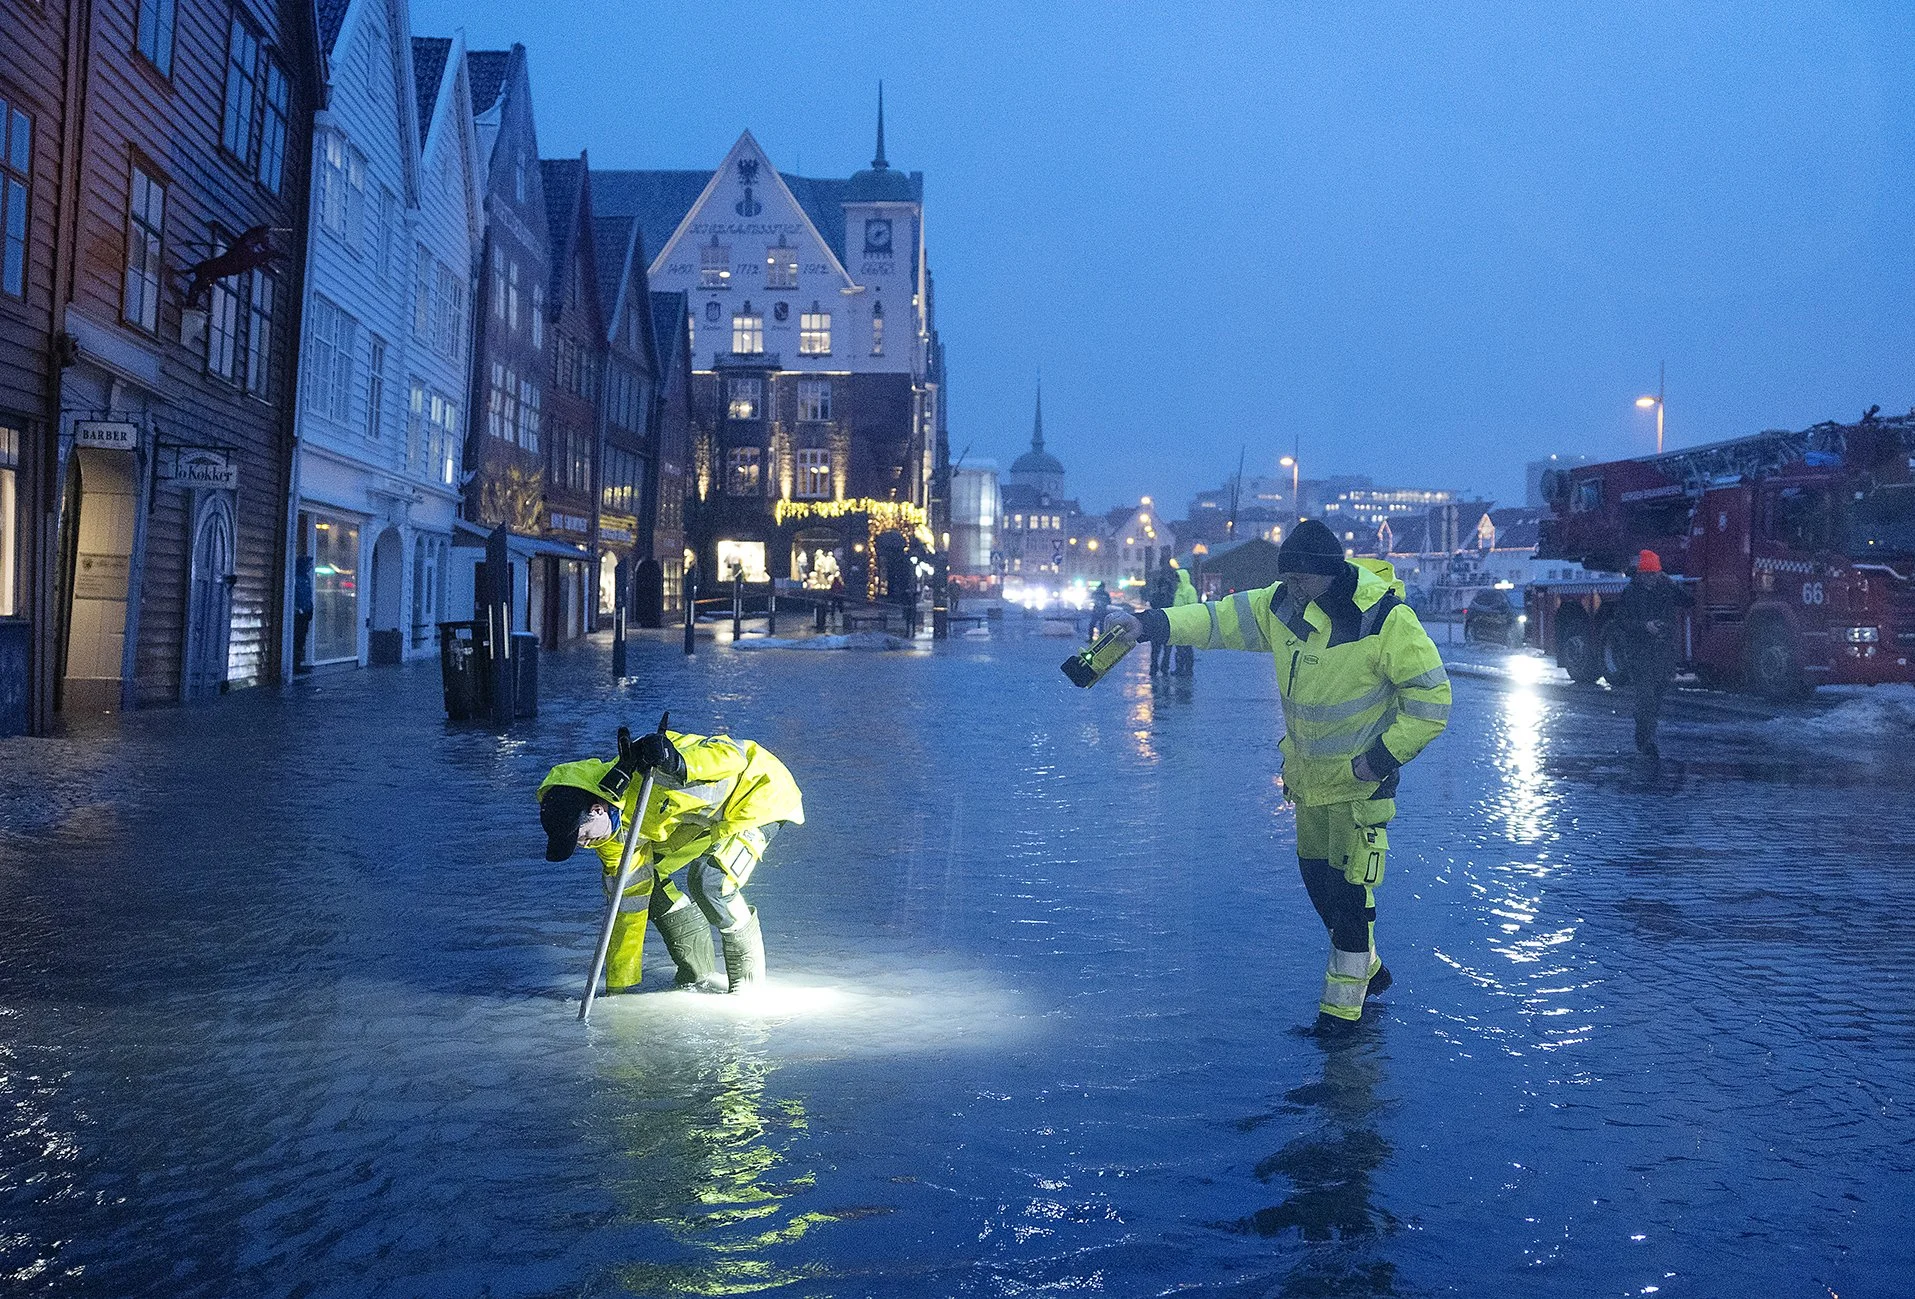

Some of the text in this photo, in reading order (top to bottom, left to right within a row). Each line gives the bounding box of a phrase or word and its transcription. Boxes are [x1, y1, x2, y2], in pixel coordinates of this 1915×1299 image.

[82, 429, 128, 441] BARBER
[188, 464, 233, 482] Kokker
[1802, 582, 1824, 605] 66
